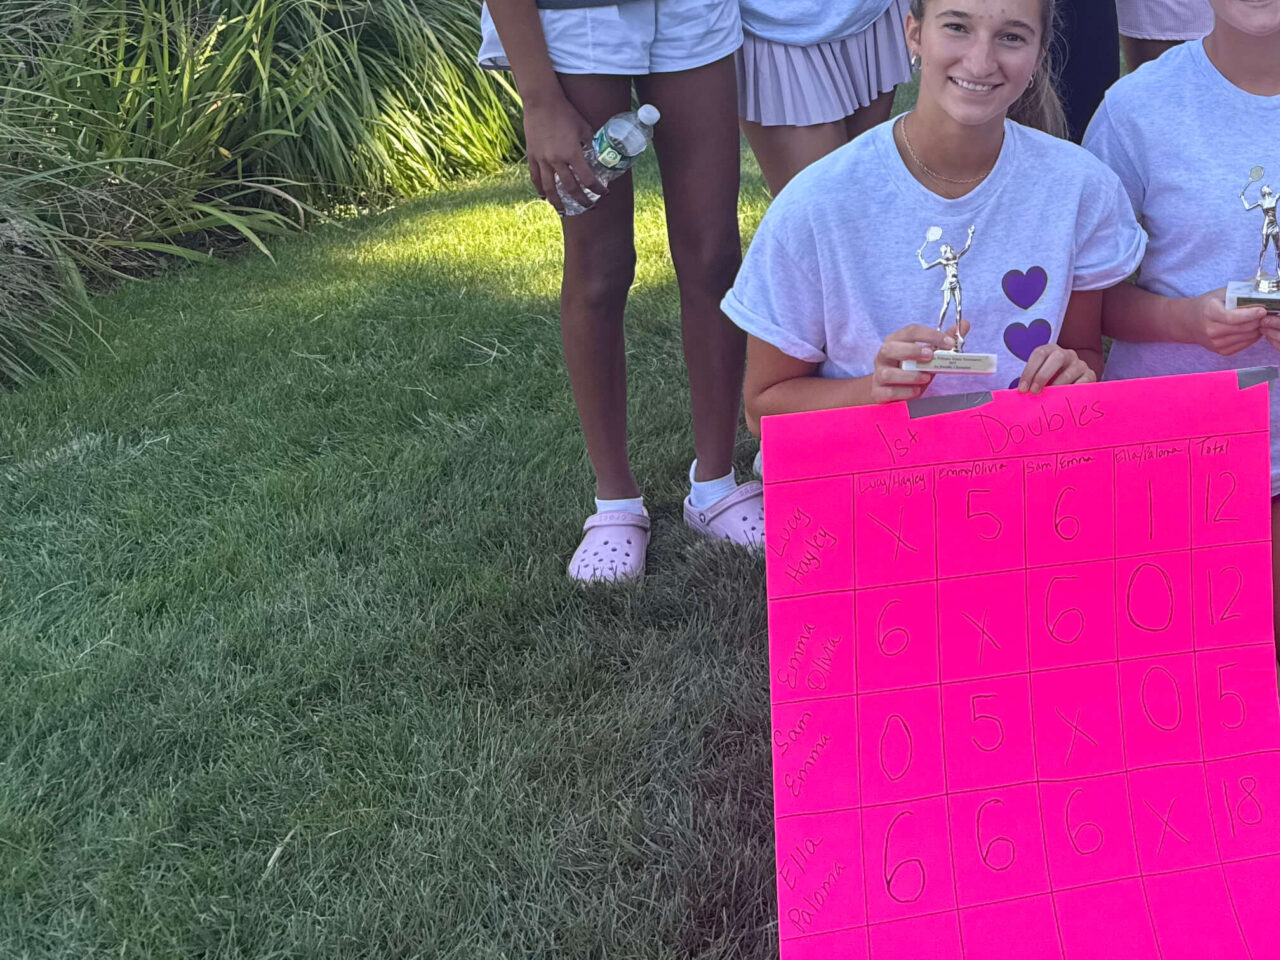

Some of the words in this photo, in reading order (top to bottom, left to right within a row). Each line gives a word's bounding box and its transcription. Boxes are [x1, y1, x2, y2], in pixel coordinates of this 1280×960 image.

[971, 398, 1104, 454] Doubles
[1195, 437, 1230, 456] Total
[967, 490, 1002, 540] 5
[1055, 486, 1080, 541] 6
[1205, 471, 1240, 524] 12
[768, 507, 811, 557] Lucy
[784, 526, 837, 584] Hayley
[1046, 576, 1084, 644] 6
[1127, 563, 1174, 632] 0
[1208, 566, 1243, 625] 12
[777, 623, 816, 690] Emma
[878, 600, 910, 657] 6
[807, 635, 842, 690] Olivia
[971, 694, 1004, 752] 5
[1142, 666, 1182, 731] 0
[1218, 663, 1245, 729] 5
[773, 712, 812, 758] Sam
[880, 714, 912, 781] 0
[784, 732, 831, 798] Emma
[977, 798, 1016, 871] 6
[1065, 789, 1104, 855] 6
[1223, 776, 1263, 839] 18
[779, 837, 824, 890] Ella
[884, 810, 925, 903] 6
[788, 862, 847, 933] Paloma
